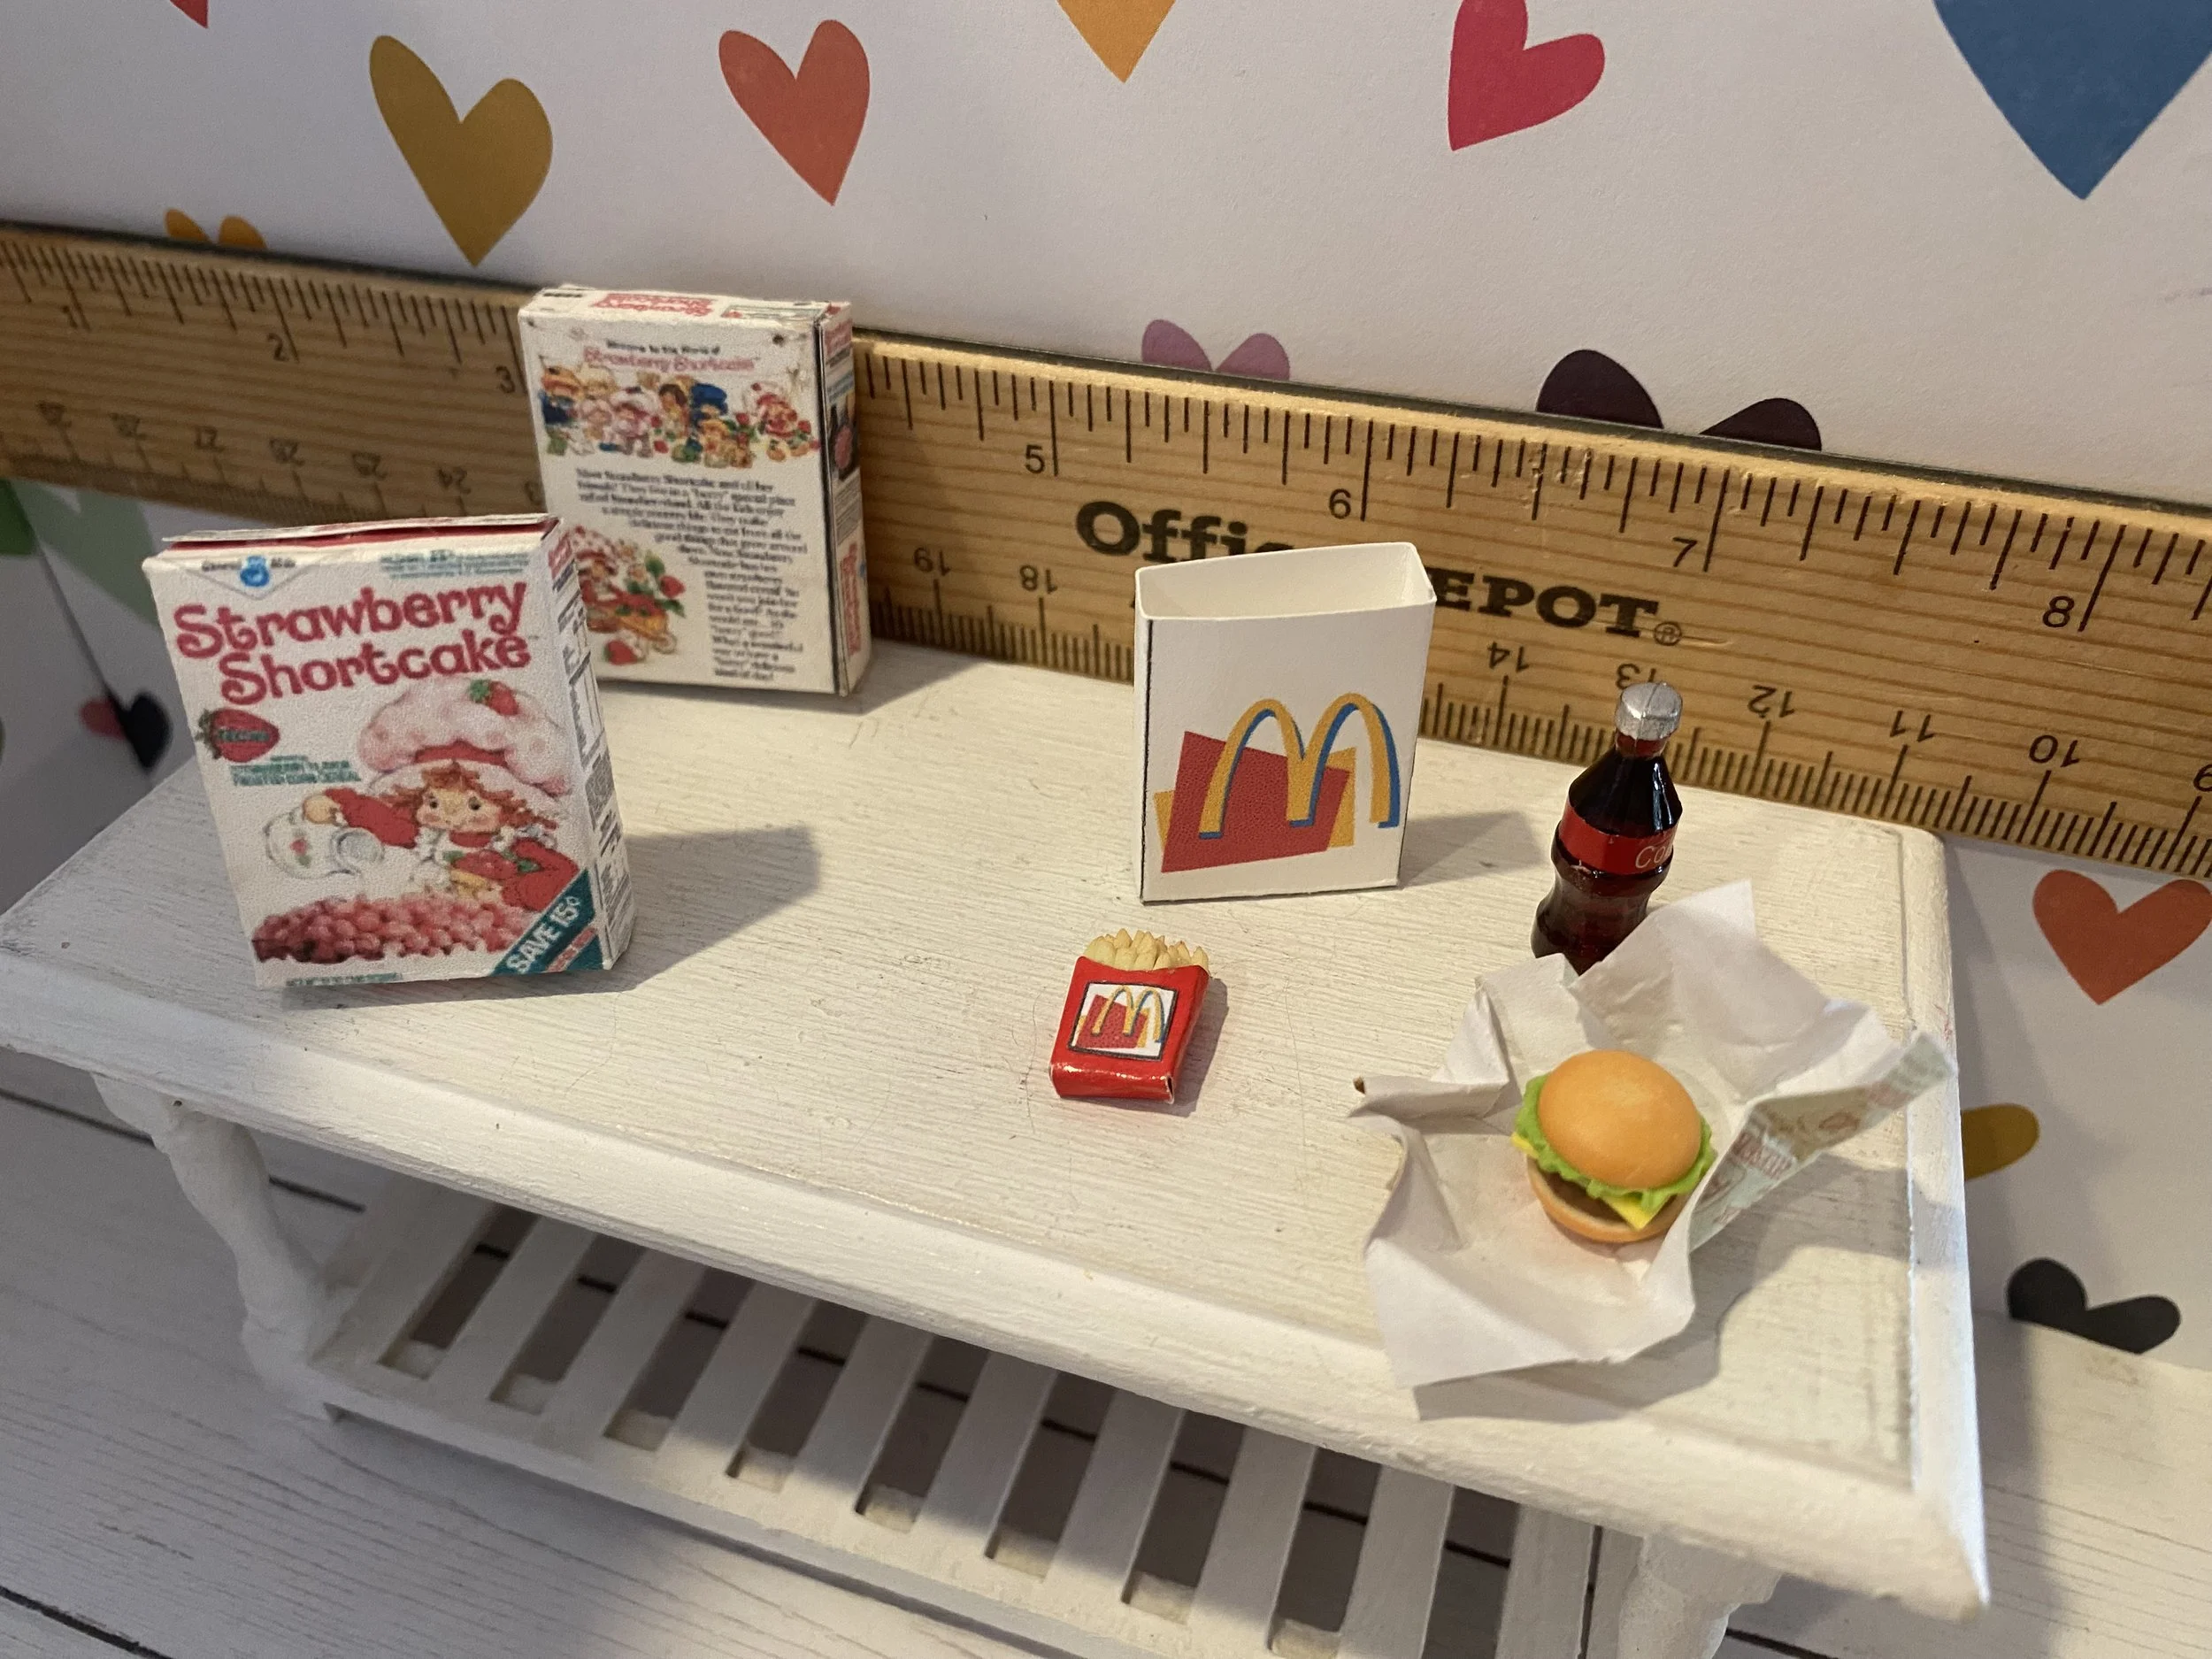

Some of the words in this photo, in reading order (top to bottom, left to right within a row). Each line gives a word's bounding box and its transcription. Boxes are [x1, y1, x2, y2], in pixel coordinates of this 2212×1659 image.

[268, 333, 290, 362] 2
[495, 366, 514, 393] 3
[1025, 444, 1046, 474] 5
[1328, 488, 1351, 519] 6
[913, 547, 951, 577] 19
[1671, 538, 1696, 568] 7
[1019, 565, 1058, 595] 18
[1076, 501, 1294, 564] Offi
[1425, 566, 1659, 638] EPOT
[173, 583, 528, 659] Strawberry
[2041, 595, 2075, 628] 8
[219, 629, 531, 705] Shortcake
[1487, 641, 1530, 673] 14
[1747, 684, 1794, 718] 12
[1890, 710, 1936, 743] 11
[2029, 734, 2079, 768] 10
[506, 923, 562, 974] SAVE
